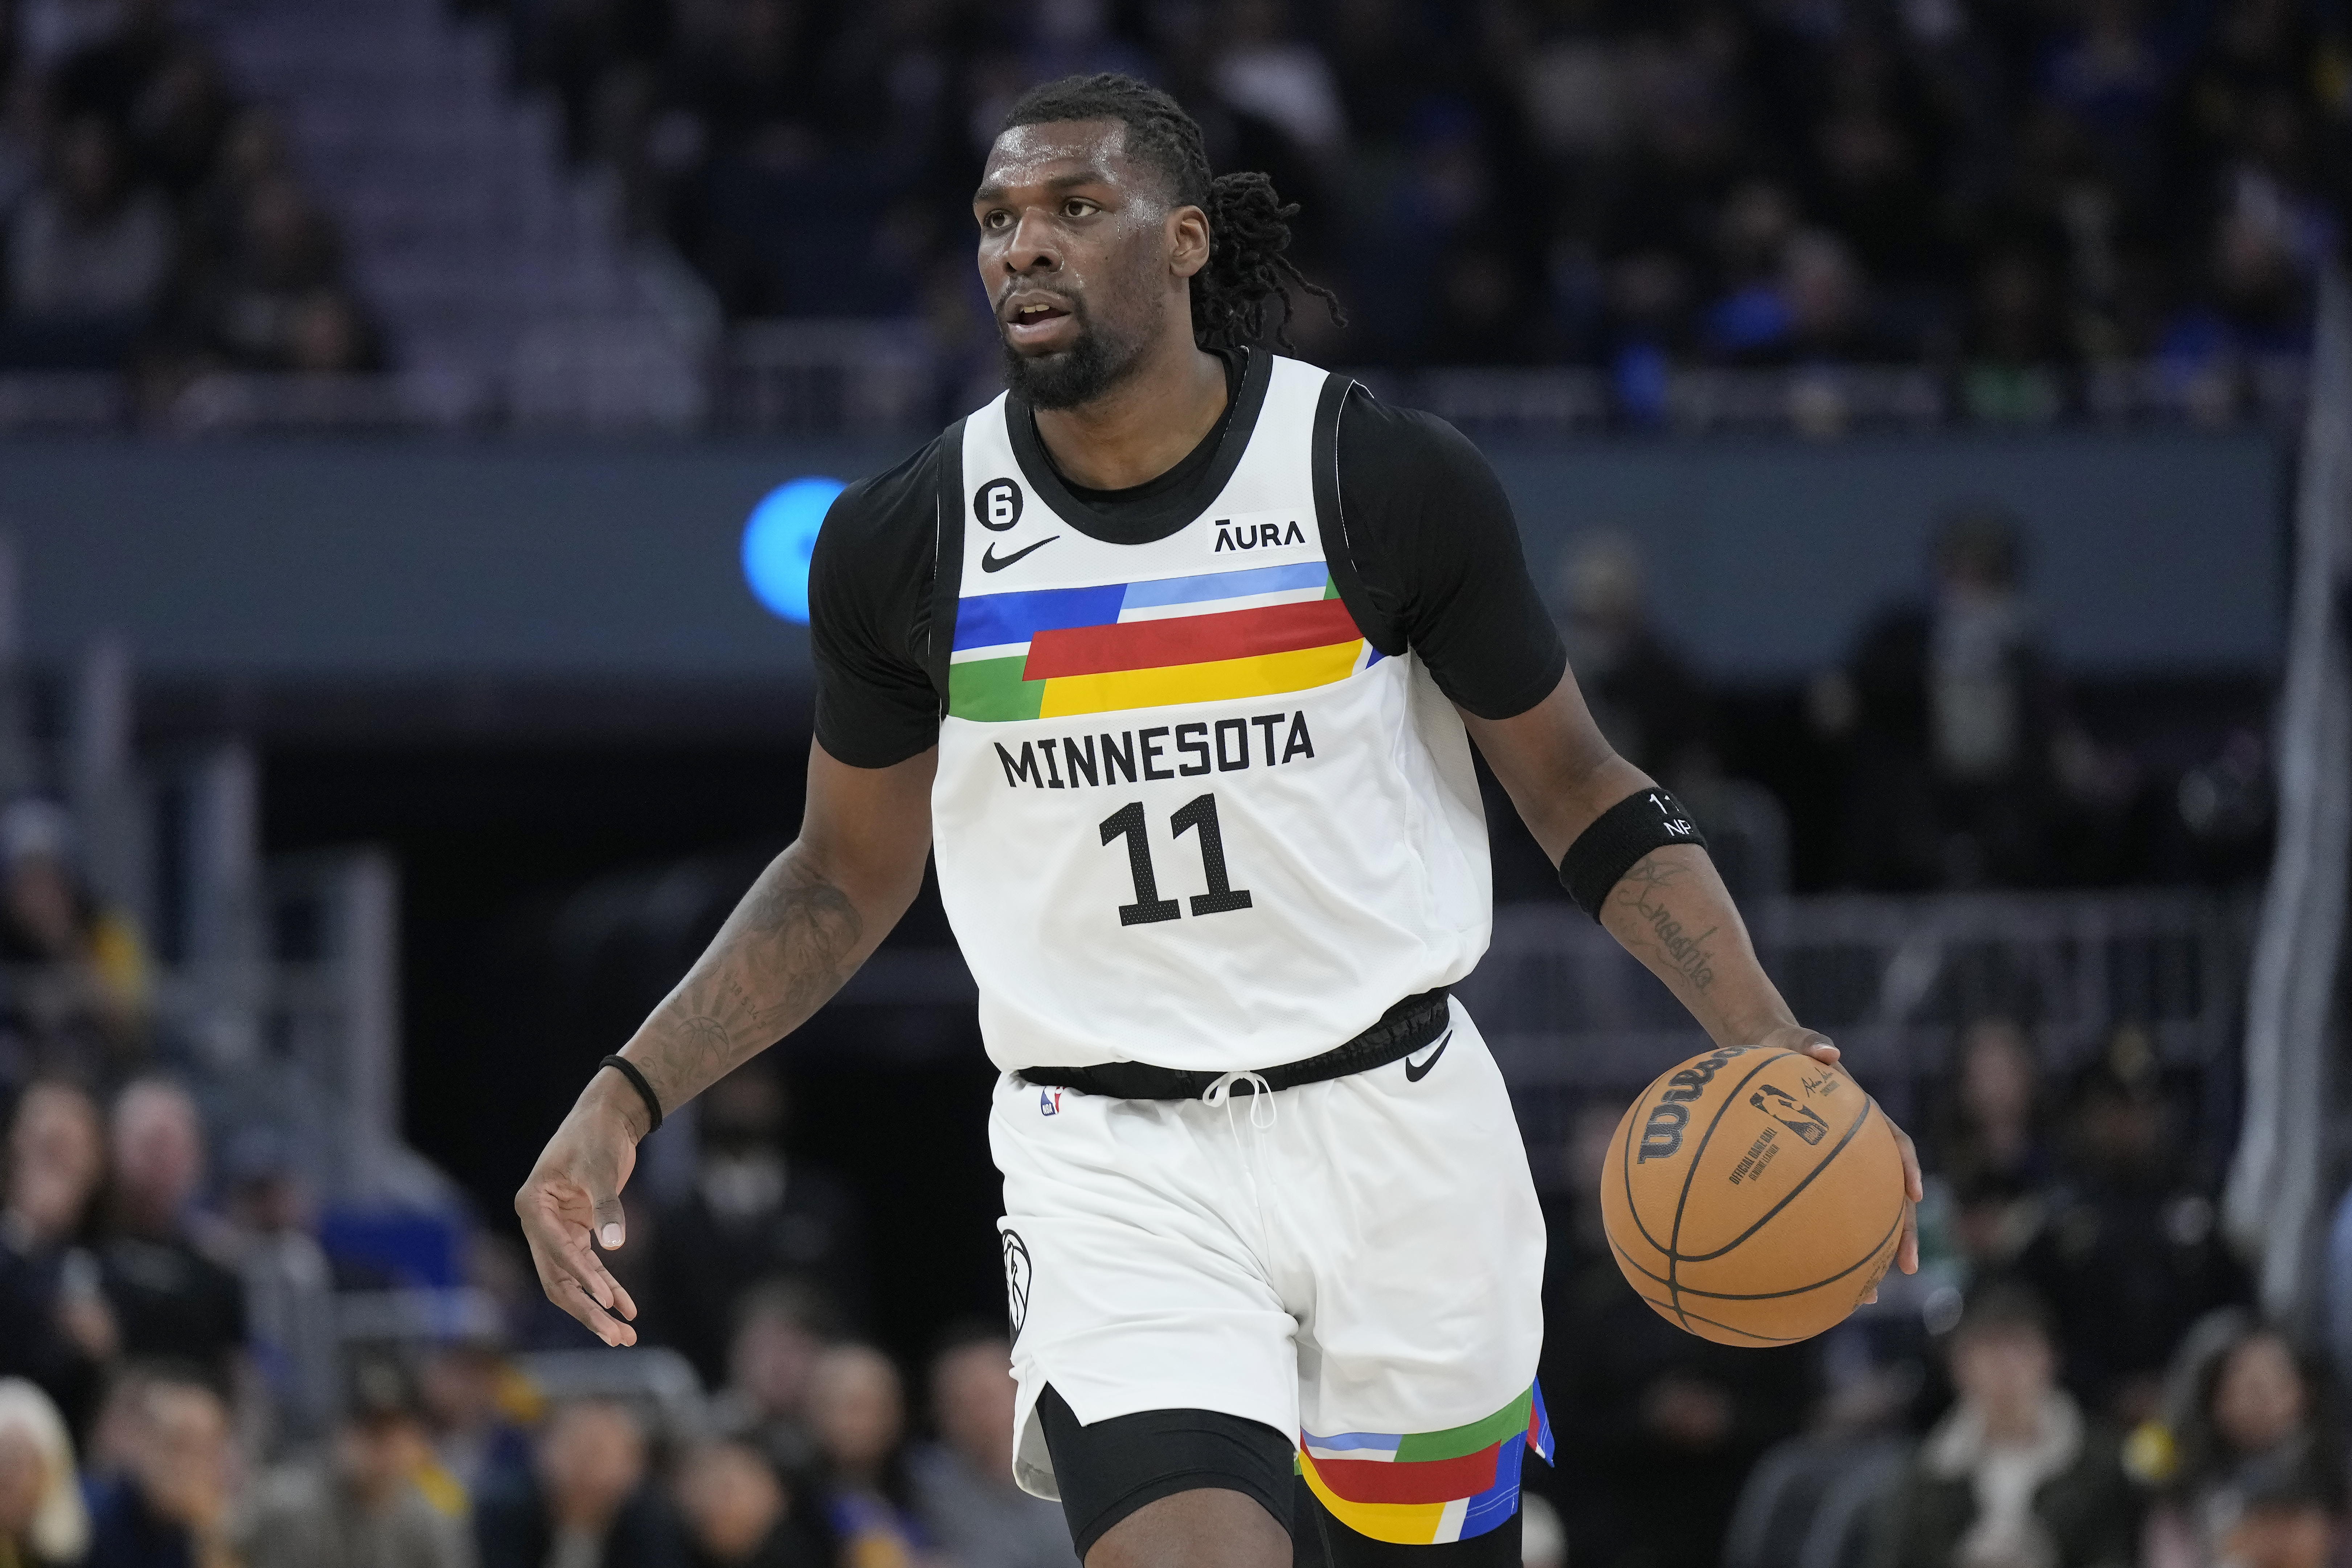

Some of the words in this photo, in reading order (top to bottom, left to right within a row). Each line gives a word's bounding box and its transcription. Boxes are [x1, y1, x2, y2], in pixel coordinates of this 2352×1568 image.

[988, 485, 1013, 525] 6
[993, 711, 1315, 789] MINNESOTA
[1099, 792, 1253, 926] 11
[1042, 1103, 1053, 1115] NBA
[1729, 1156, 1755, 1185] OFFICIAL
